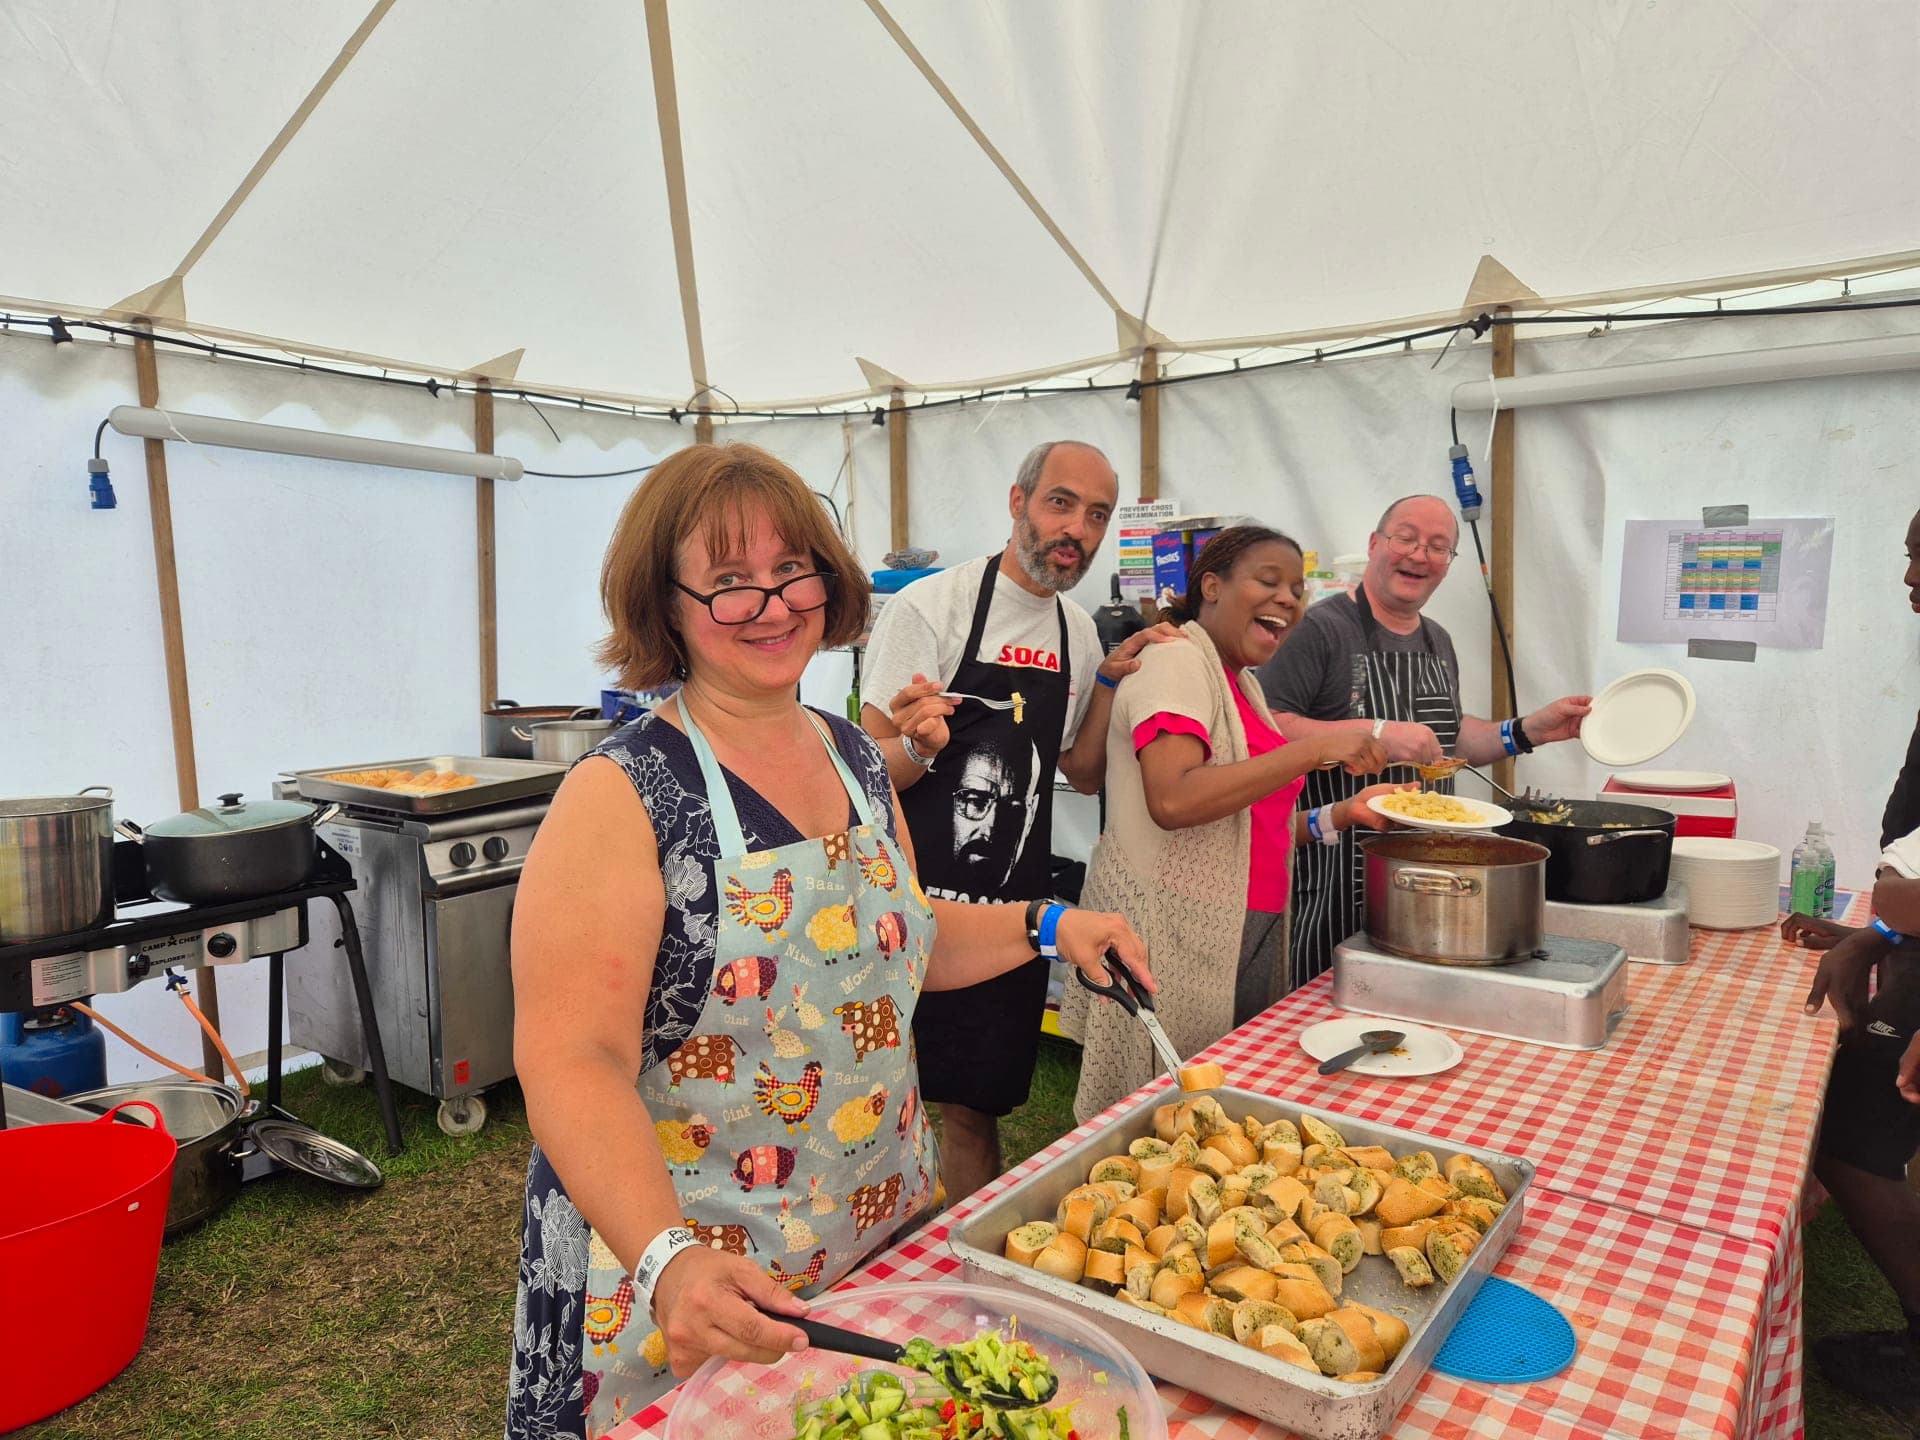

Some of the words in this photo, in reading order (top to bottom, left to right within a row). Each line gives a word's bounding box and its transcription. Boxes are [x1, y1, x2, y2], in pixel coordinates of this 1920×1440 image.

[1119, 505, 1149, 513] PREVENT
[1119, 511, 1174, 520] CONTAMINATION
[998, 644, 1059, 672] SOCA
[142, 942, 166, 952] CAMP
[179, 935, 202, 945] CHEF
[150, 954, 186, 966] EXPLORER
[723, 1013, 750, 1027] Oink
[1869, 1020, 1896, 1034] NIKE
[722, 1104, 753, 1123] Oink
[739, 1200, 764, 1216] Oink
